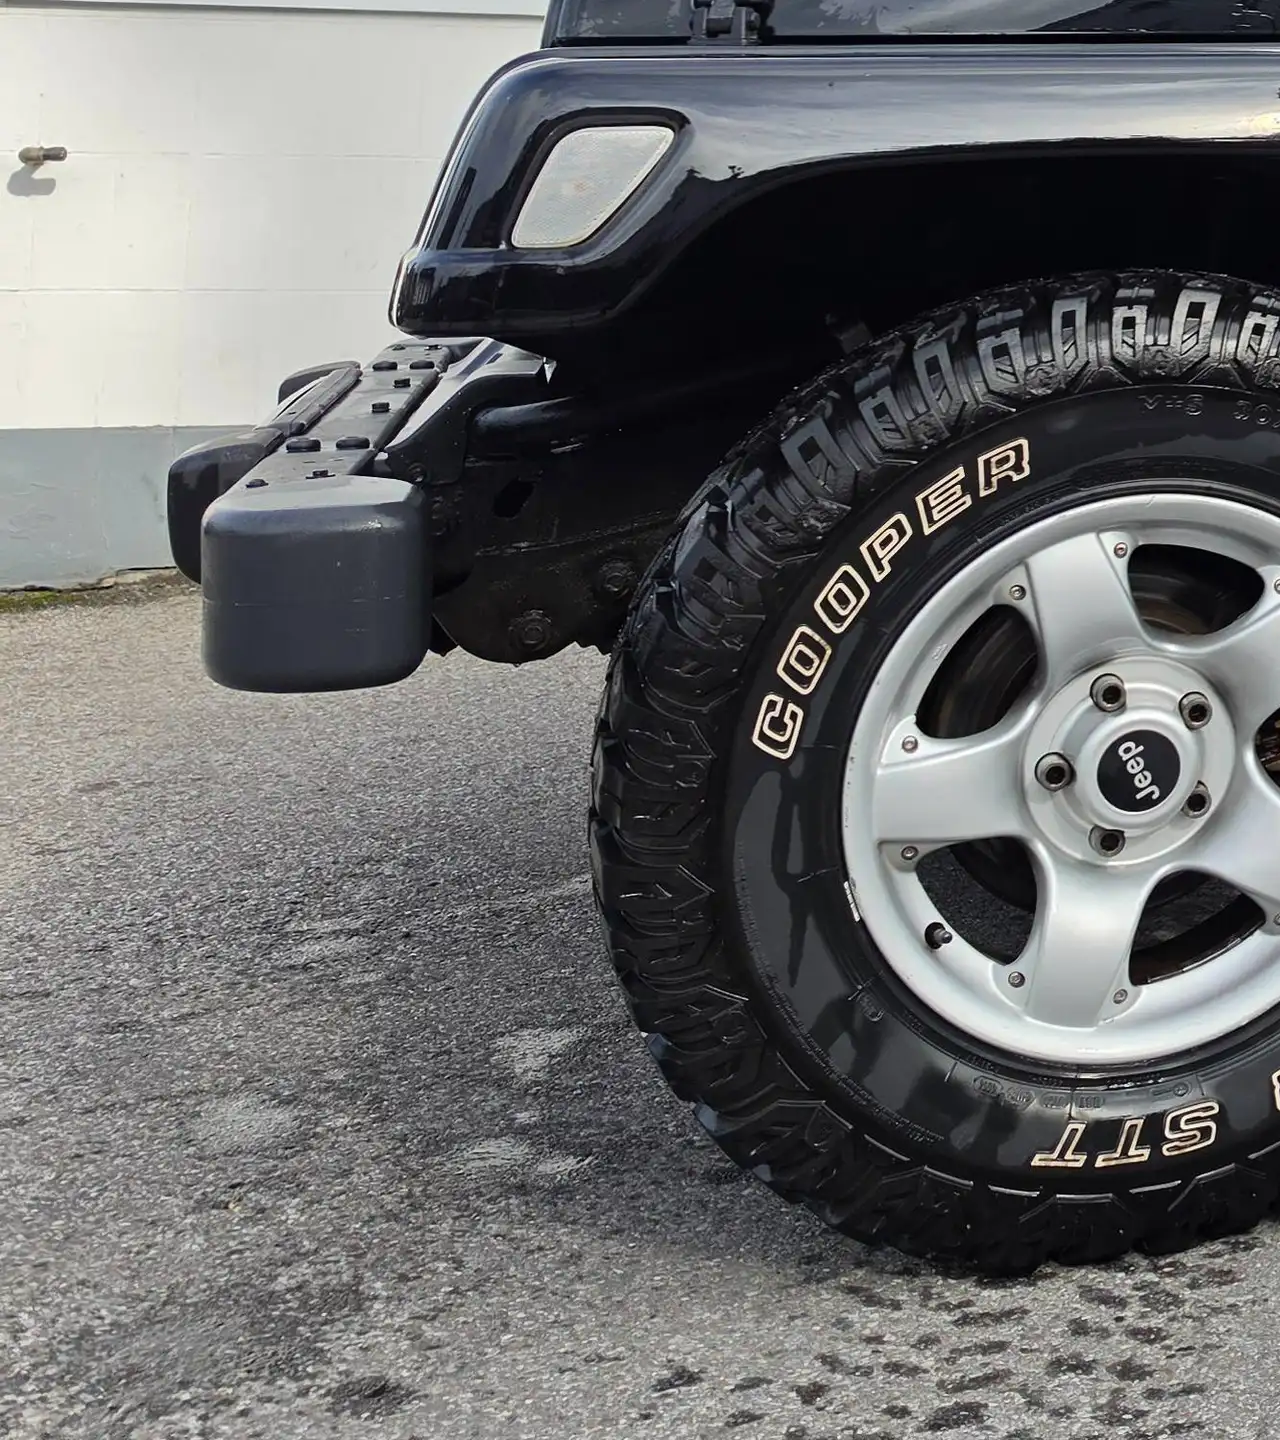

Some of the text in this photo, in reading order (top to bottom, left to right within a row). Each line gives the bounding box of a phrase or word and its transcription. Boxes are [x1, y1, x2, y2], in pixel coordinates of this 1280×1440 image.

[751, 437, 1031, 760] COOPER
[1118, 741, 1160, 800] Jeep
[1031, 1099, 1220, 1168] STT
